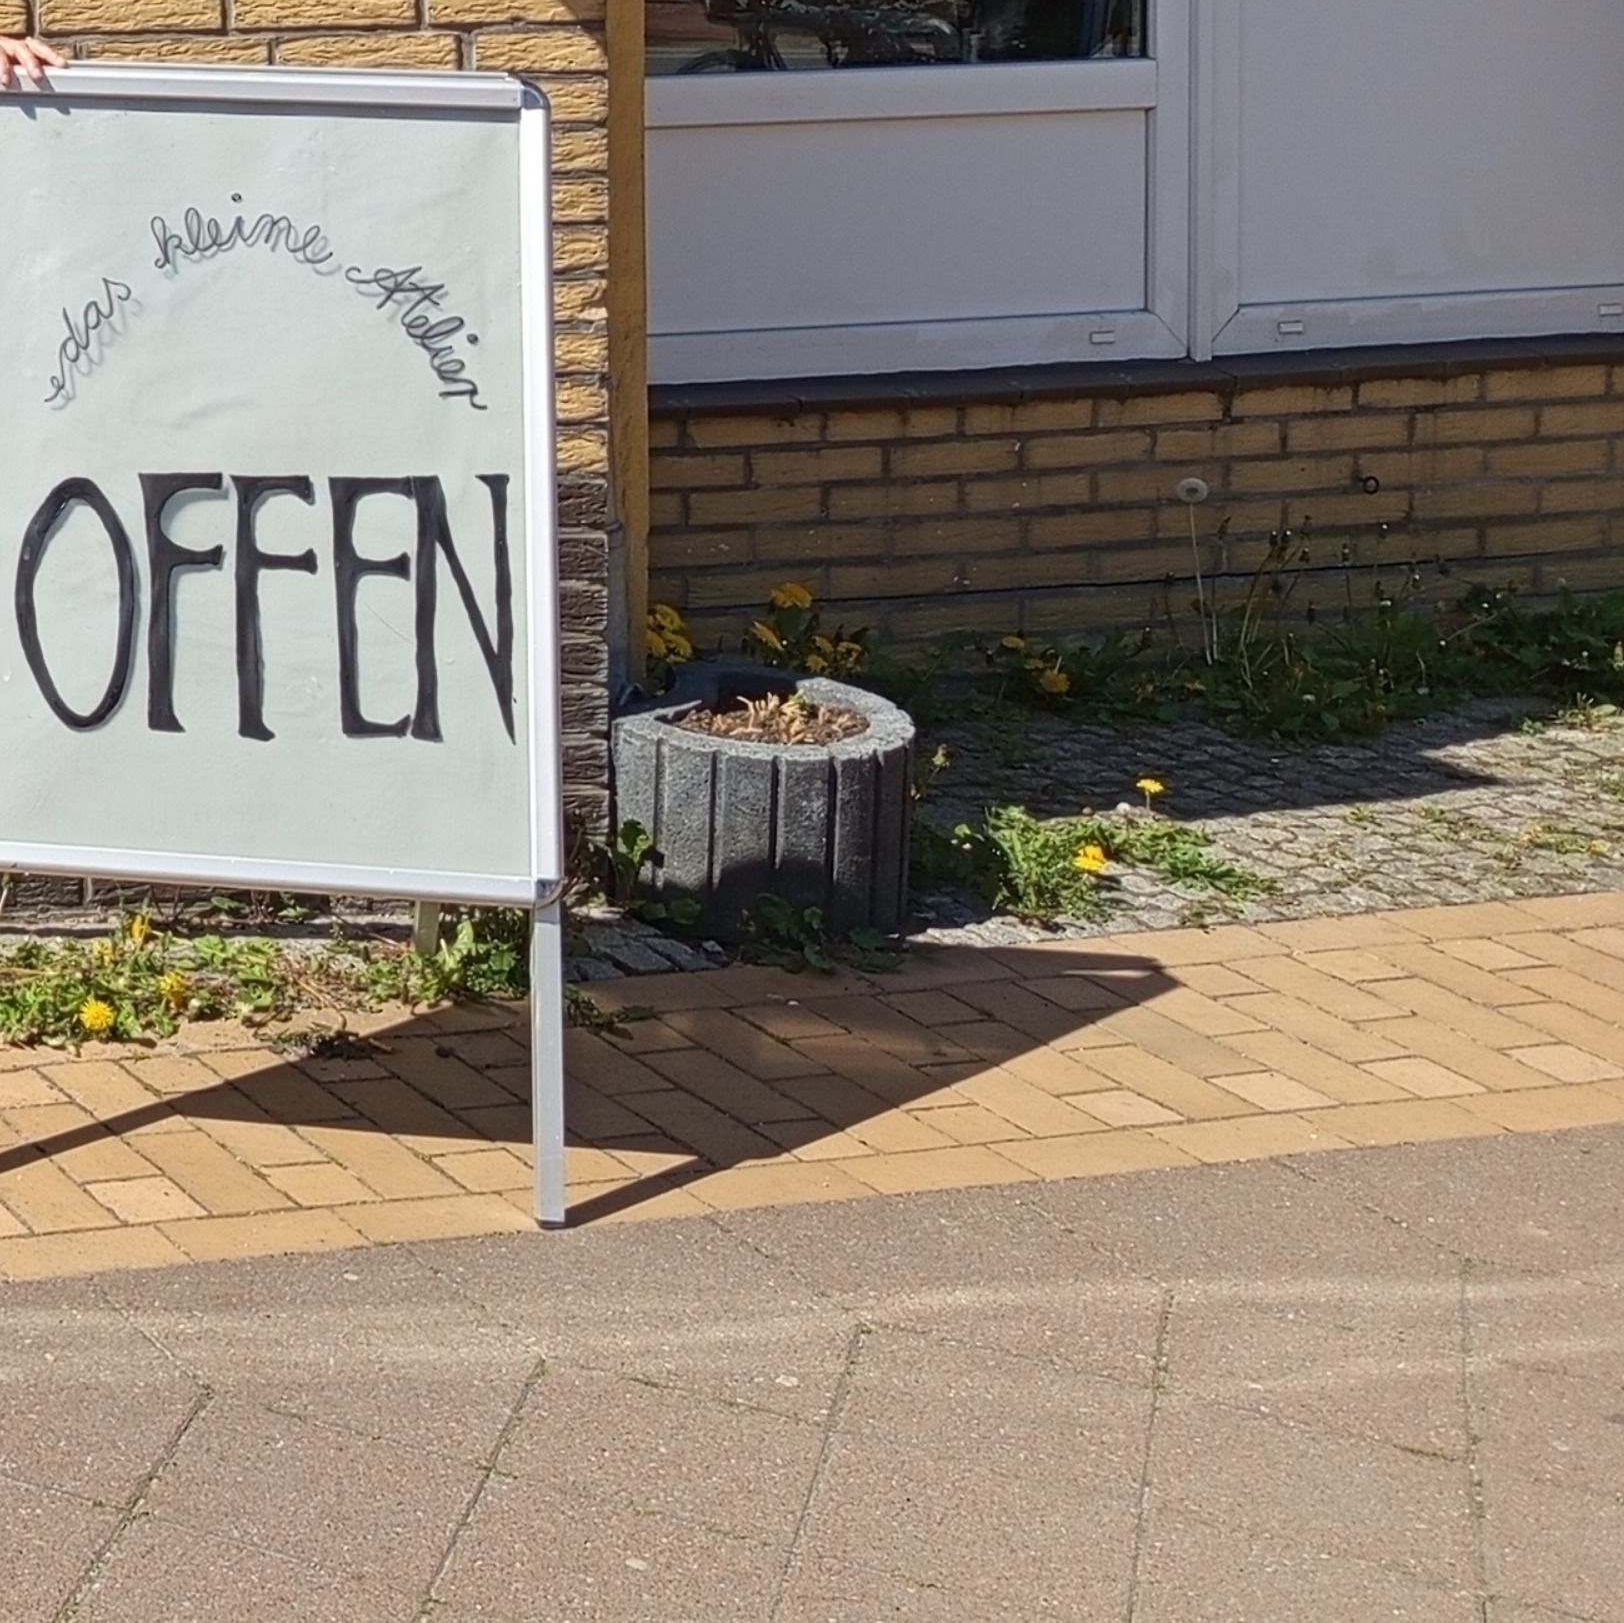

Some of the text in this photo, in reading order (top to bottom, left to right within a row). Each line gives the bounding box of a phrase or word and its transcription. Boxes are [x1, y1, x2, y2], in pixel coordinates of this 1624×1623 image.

[44, 190, 488, 410] das kleine Atelier
[14, 472, 516, 745] OFFEN
